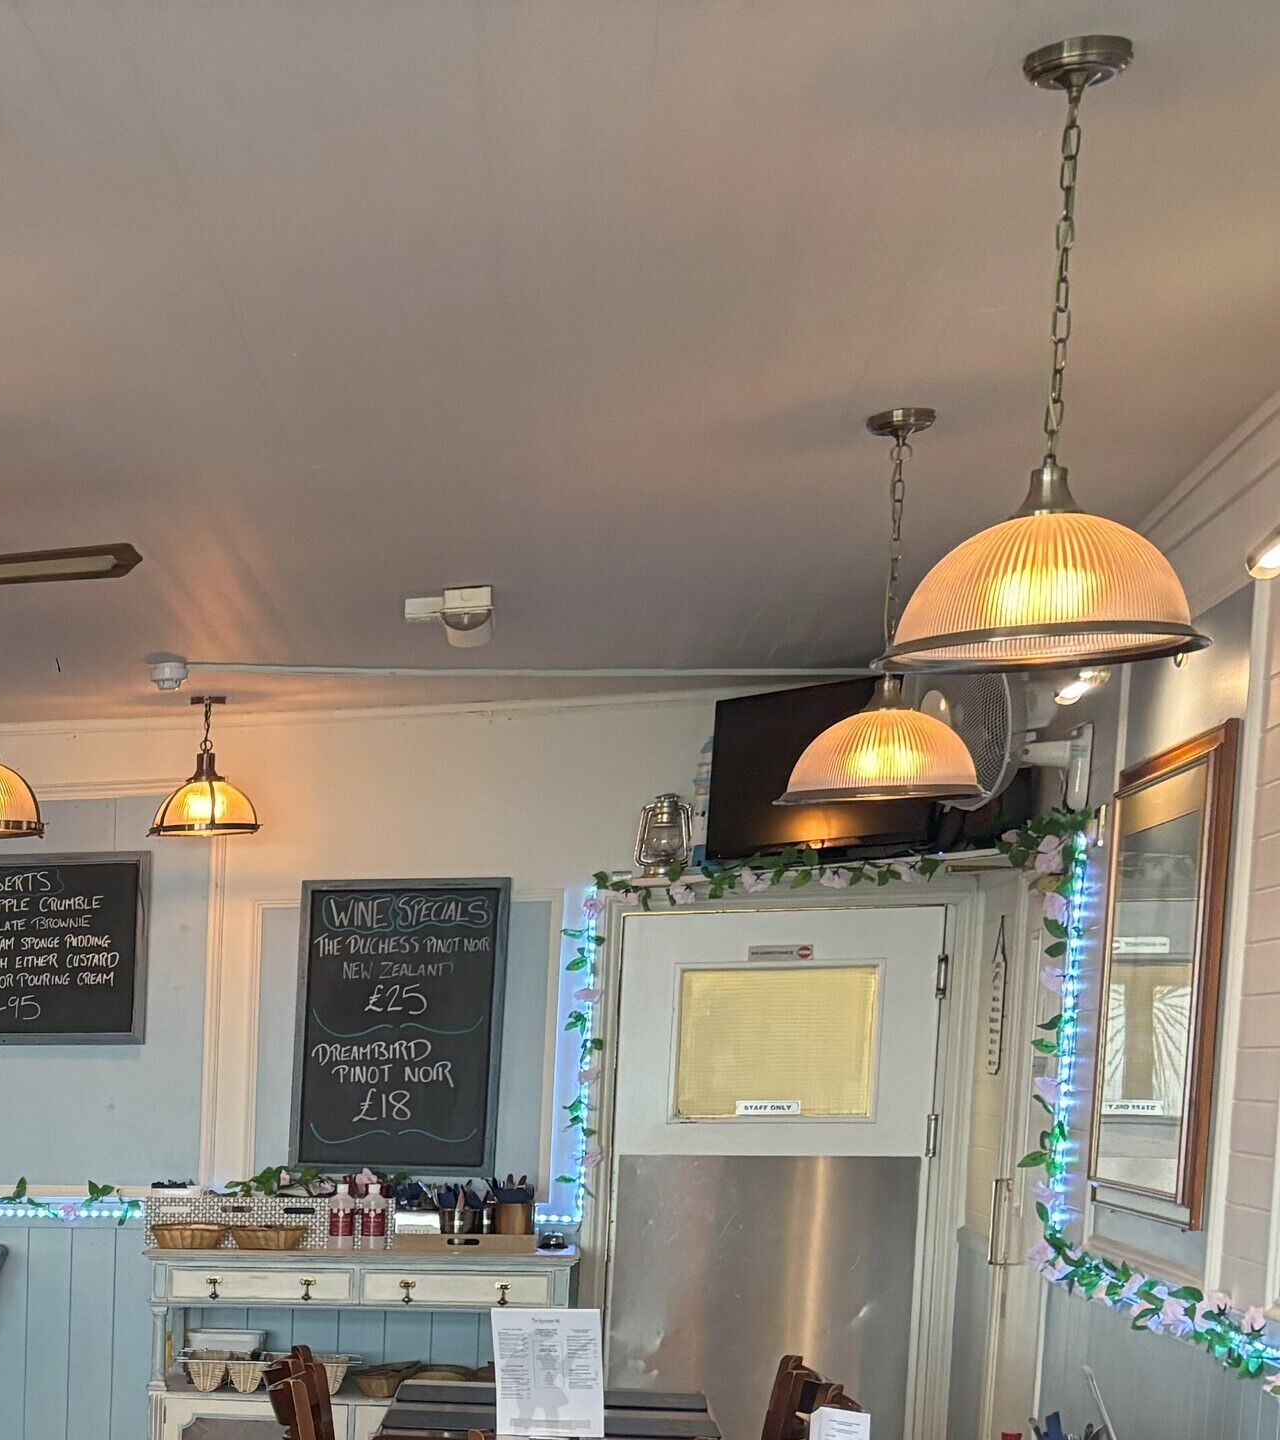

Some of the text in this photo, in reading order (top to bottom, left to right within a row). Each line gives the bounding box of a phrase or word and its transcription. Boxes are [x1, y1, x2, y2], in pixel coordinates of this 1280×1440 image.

[39, 896, 104, 913] CRUMBLE
[330, 897, 487, 928] WINE SPECIALS
[31, 915, 92, 930] BROWNIE
[21, 937, 59, 950] SPONGE
[65, 935, 111, 949] PUDDING
[314, 933, 490, 957] THE DUCHESS PINOT NOIR
[15, 953, 58, 968] EITHER
[66, 952, 119, 968] CUSTARD
[343, 961, 455, 979] NEW ZEALAND
[17, 973, 70, 988] POURING
[77, 972, 114, 987] CREAM
[364, 983, 428, 1015] £25
[312, 1039, 432, 1066] DREAMBIRD
[331, 1061, 455, 1088] PINOT NOIR
[352, 1088, 412, 1122] £18
